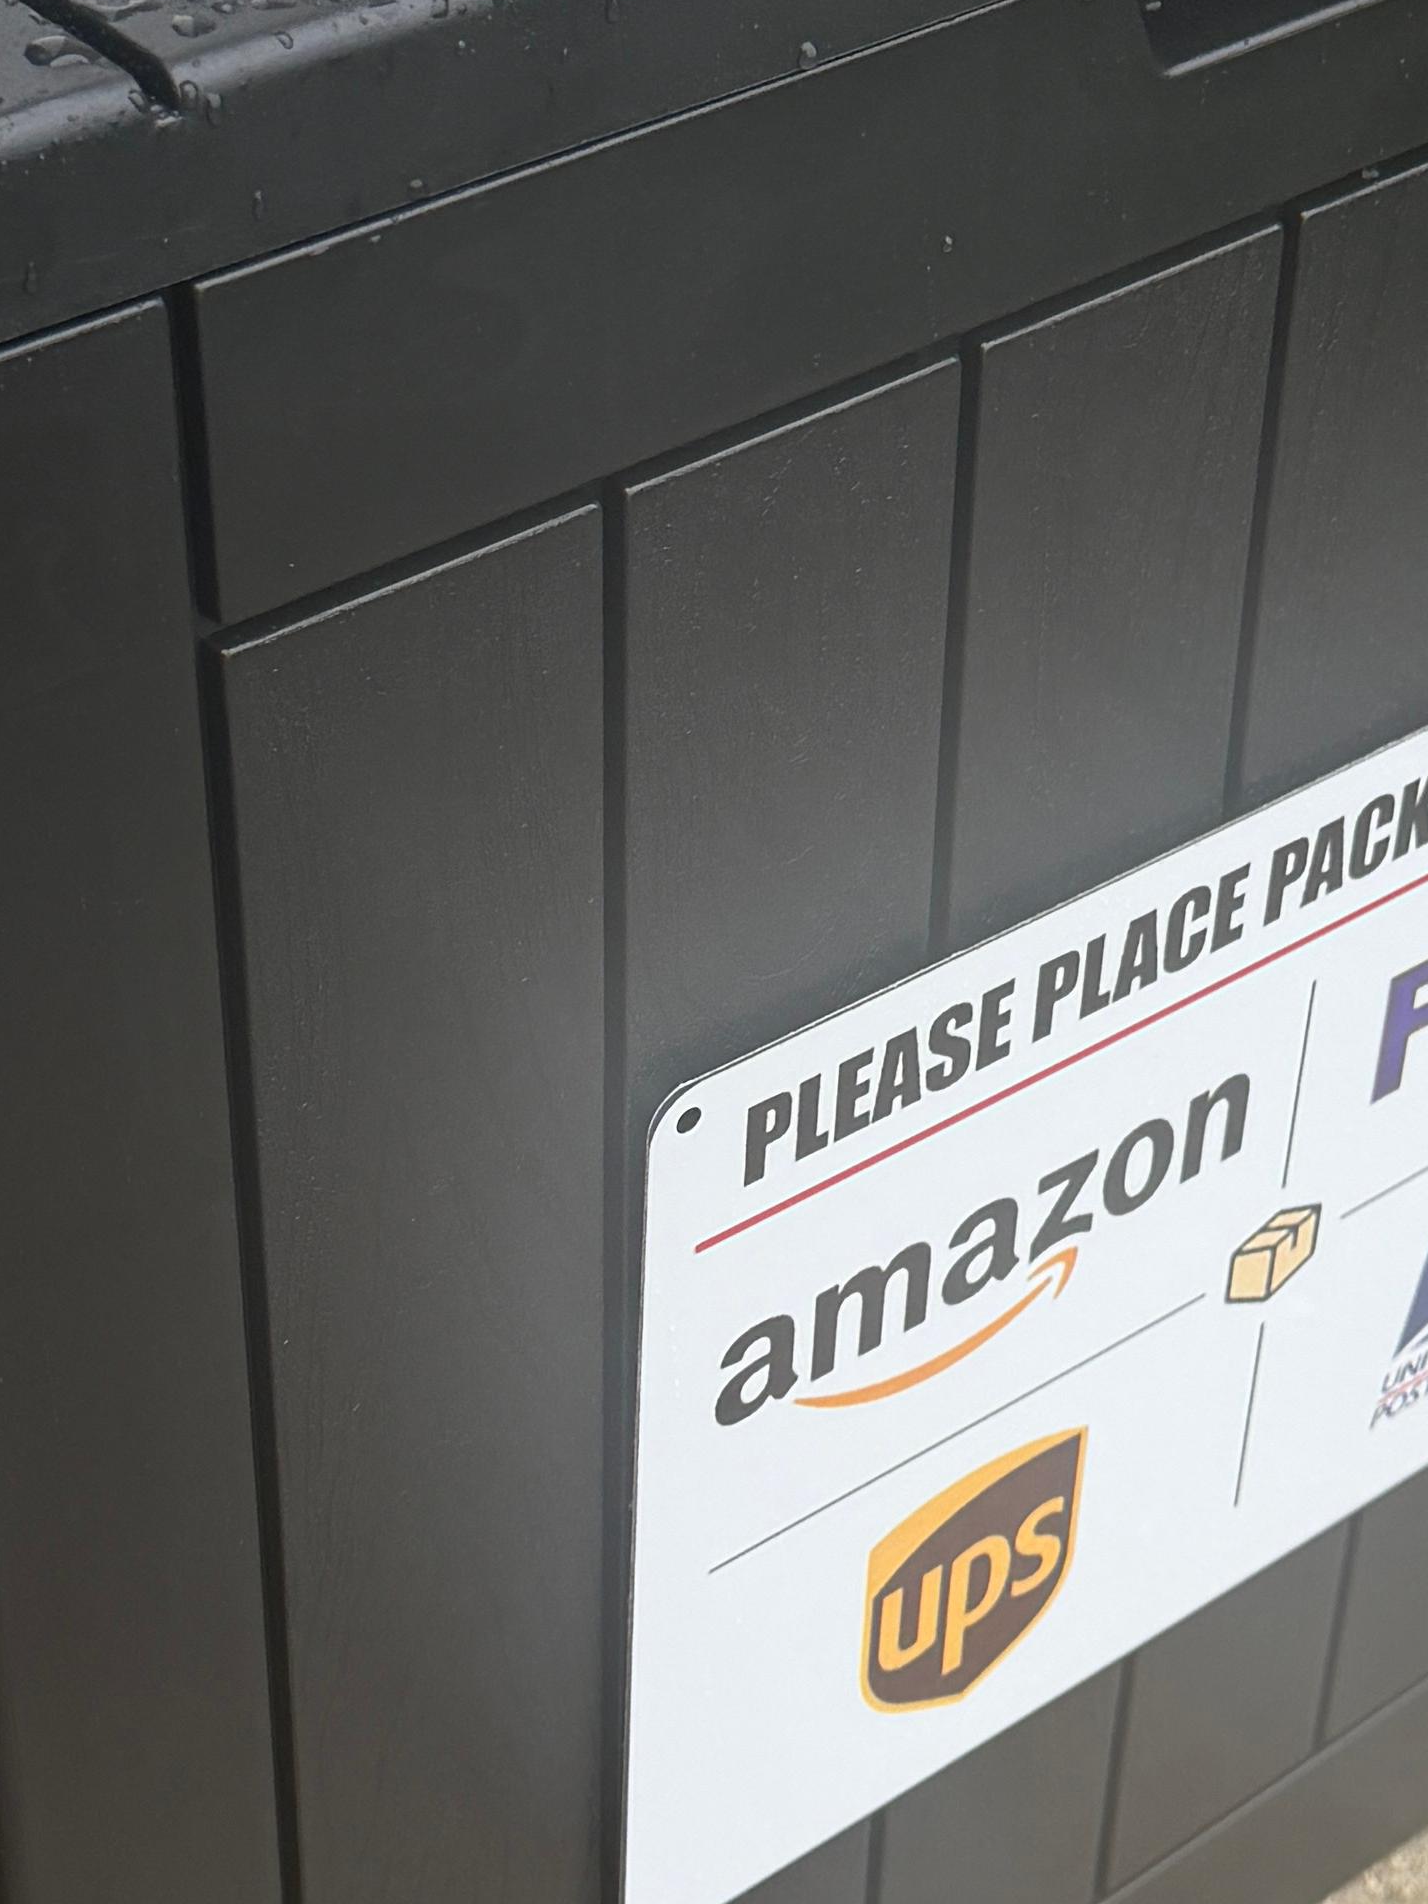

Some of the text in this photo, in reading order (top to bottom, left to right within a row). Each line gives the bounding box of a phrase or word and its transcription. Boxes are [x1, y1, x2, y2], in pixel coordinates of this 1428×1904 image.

[743, 978, 1015, 1188] PLEASE
[1032, 862, 1251, 1044] PLACE
[714, 1072, 1250, 1427] amazon
[877, 1495, 1066, 1676] ups
